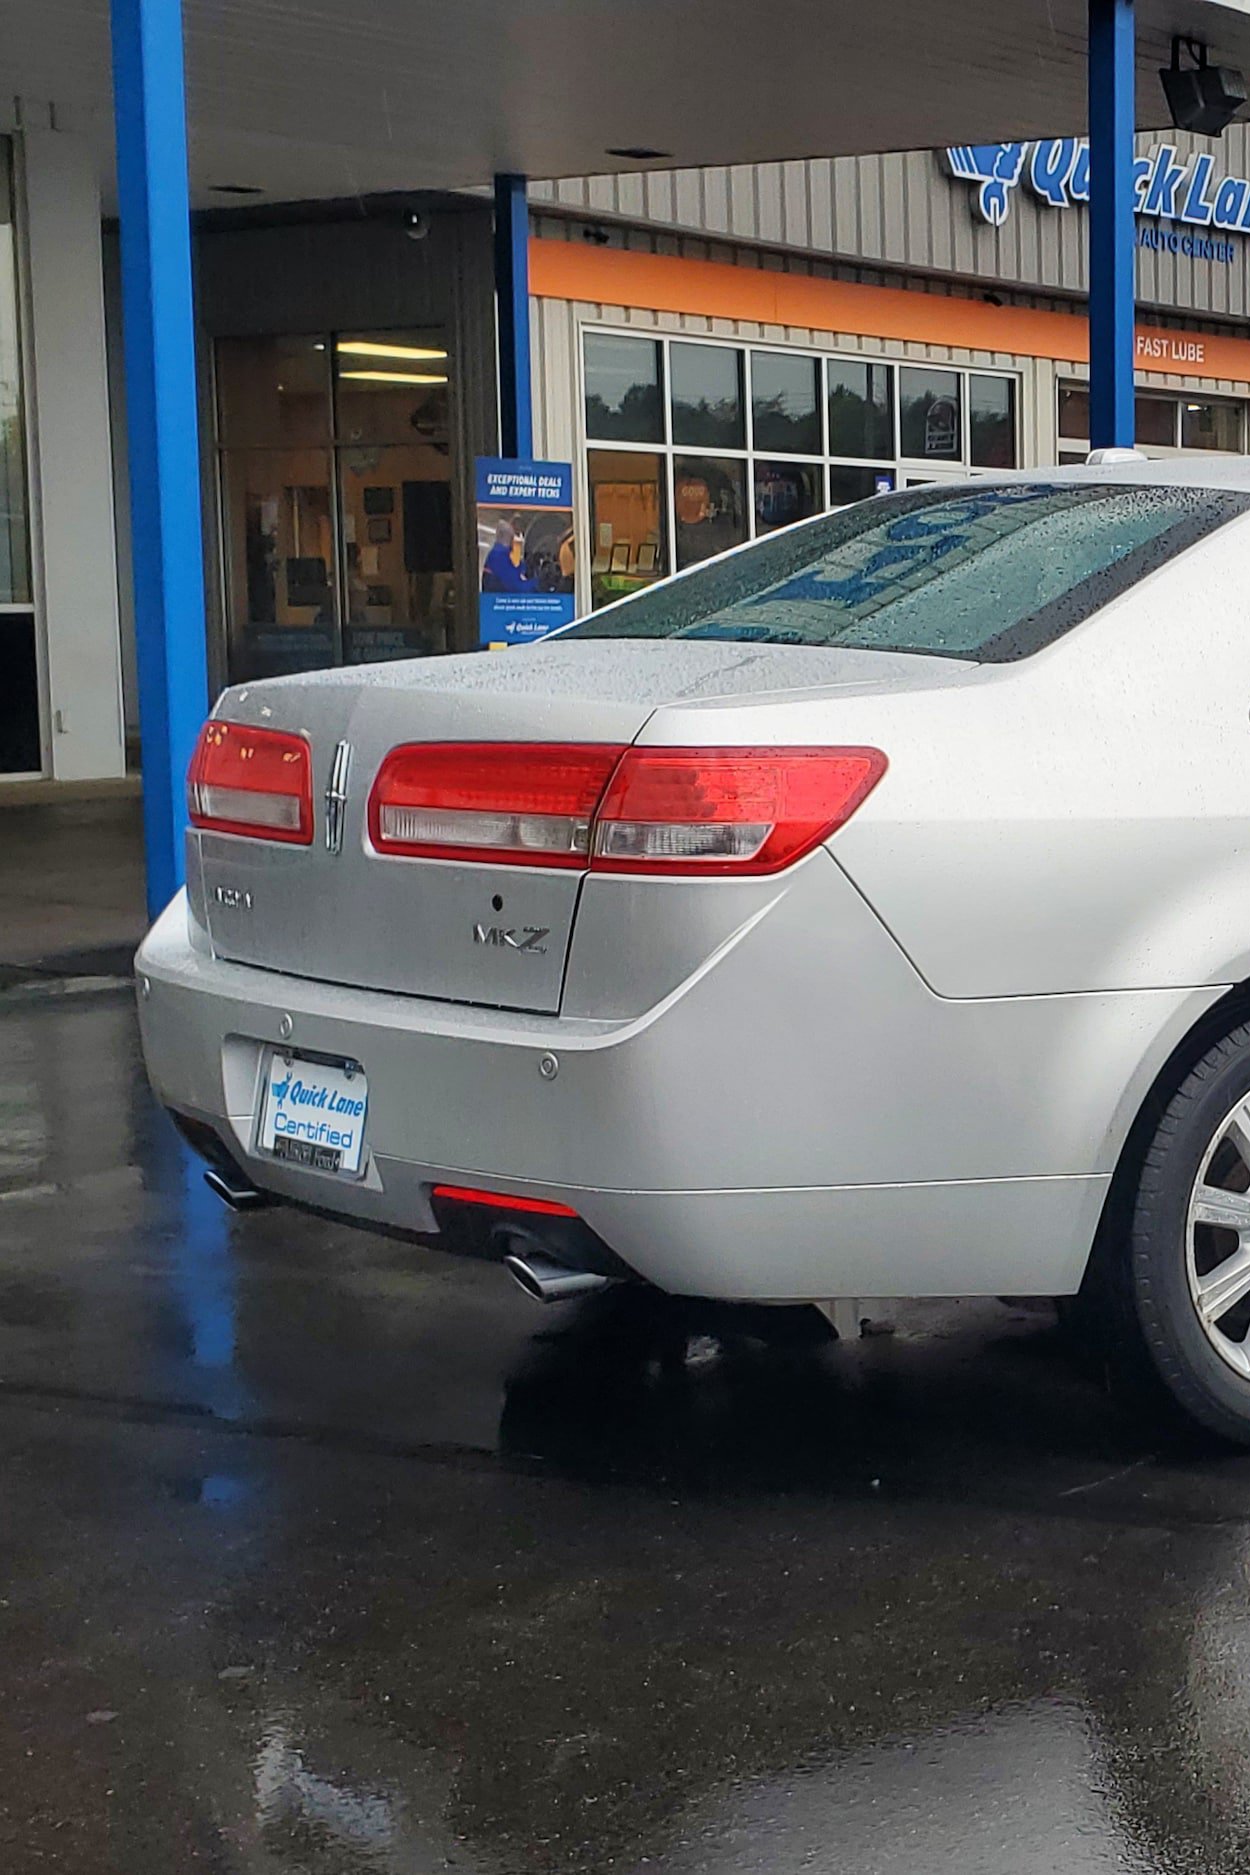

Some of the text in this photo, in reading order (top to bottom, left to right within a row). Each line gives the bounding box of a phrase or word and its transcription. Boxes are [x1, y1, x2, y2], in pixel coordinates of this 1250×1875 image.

[1140, 230, 1235, 263] AUTO CENTER
[1137, 336, 1205, 363] FAST LUBE
[487, 473, 562, 488] EXCEPTIONAL DEALS
[489, 485, 560, 499] AND EXPERT TECHS
[473, 923, 550, 954] MKZ
[290, 1080, 364, 1117] Quick Lane
[274, 1112, 354, 1149] Certified
